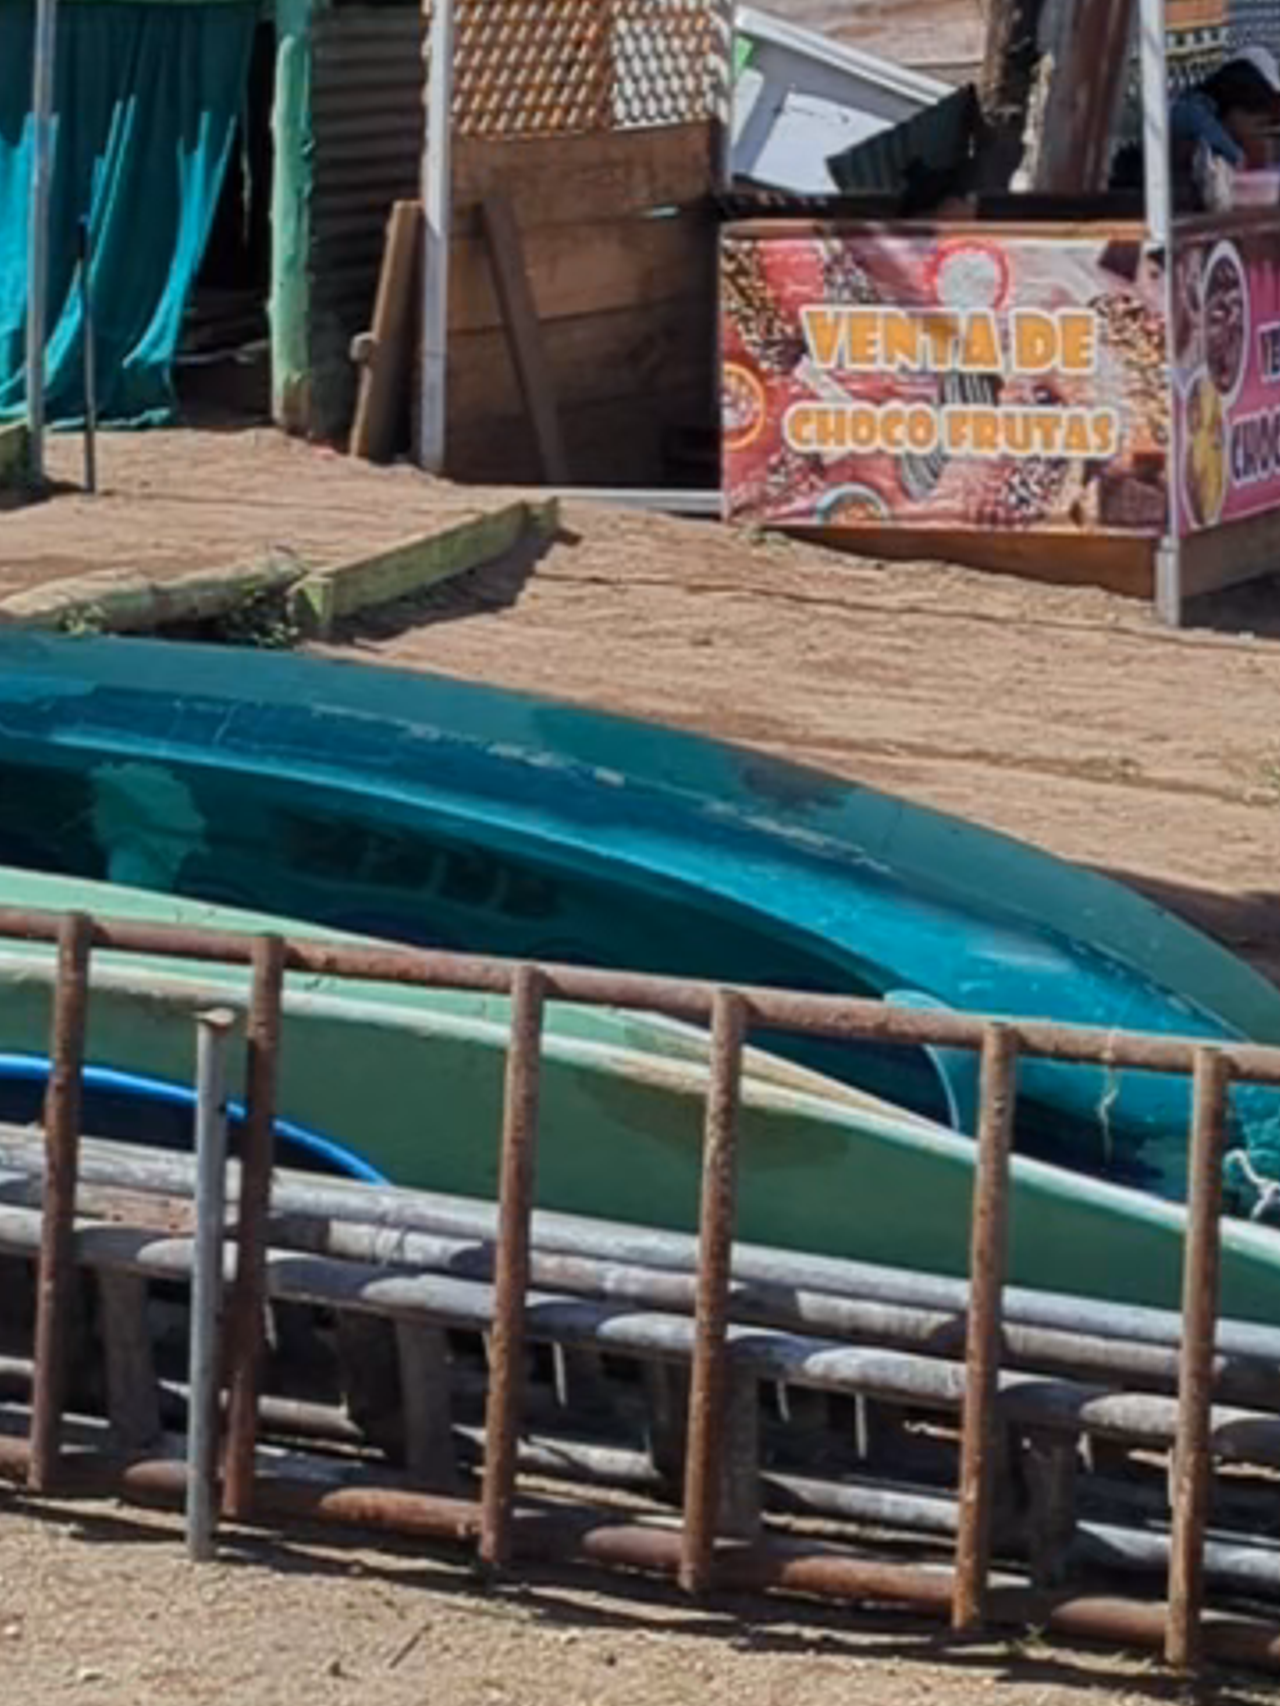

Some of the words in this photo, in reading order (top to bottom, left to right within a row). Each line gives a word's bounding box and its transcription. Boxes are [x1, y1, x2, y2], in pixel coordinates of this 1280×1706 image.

[801, 306, 1002, 372] VENTA
[1010, 308, 1095, 373] DE
[784, 402, 937, 454] CHOCO
[941, 404, 1118, 458] FRUTAS
